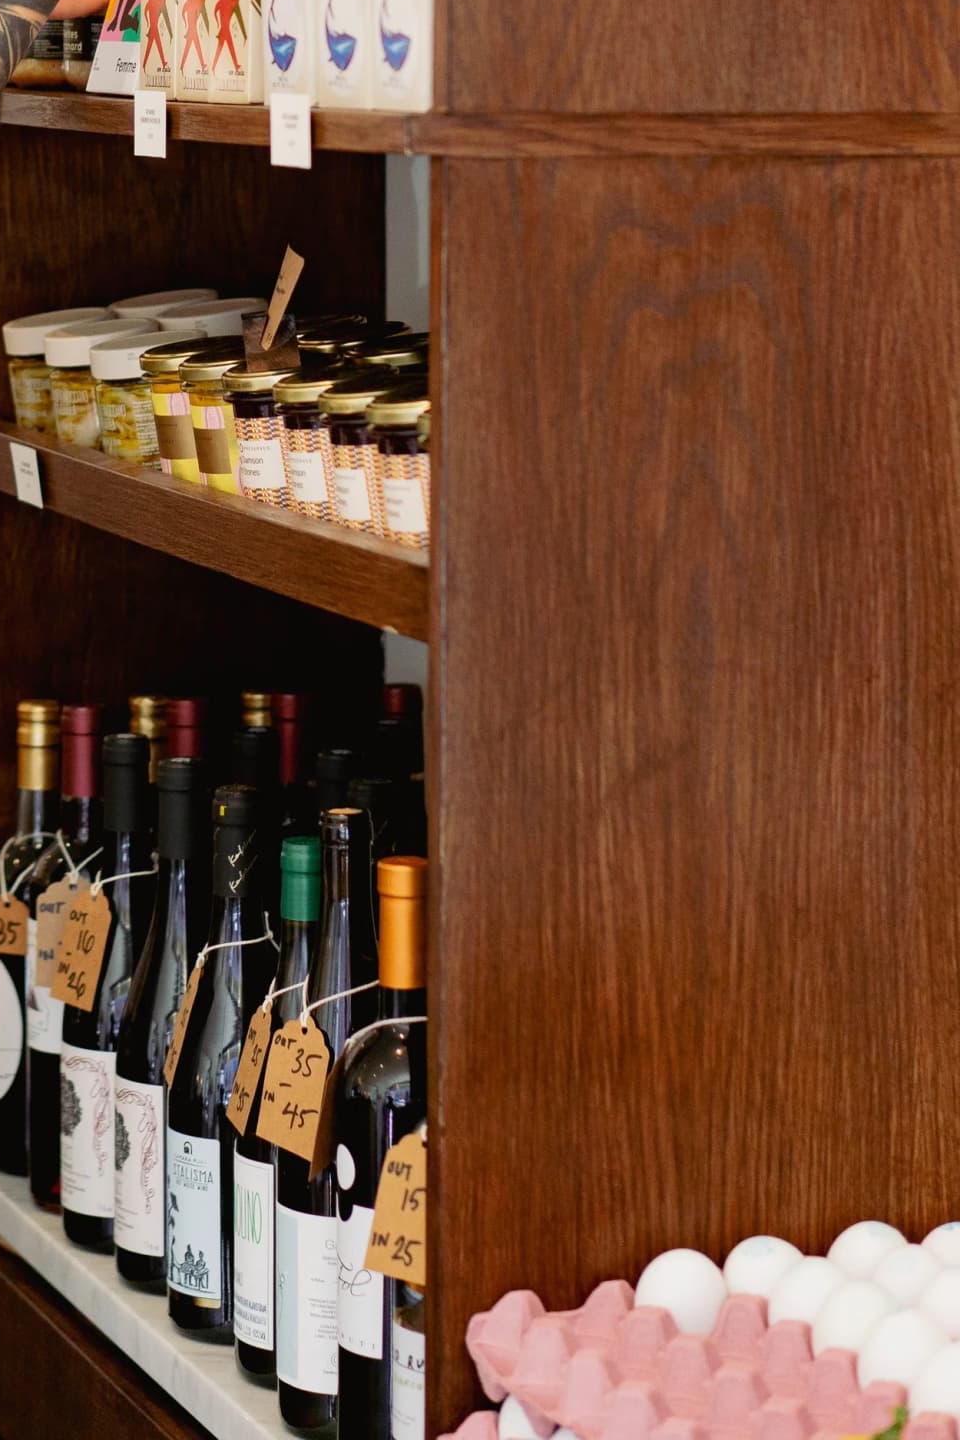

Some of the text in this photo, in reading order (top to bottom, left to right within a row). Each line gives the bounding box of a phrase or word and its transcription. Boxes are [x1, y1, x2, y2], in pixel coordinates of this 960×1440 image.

[70, 910, 88, 925] OUT
[77, 929, 95, 956] 16
[58, 962, 70, 974] IN
[275, 1034, 323, 1078] OUT 35
[264, 1090, 319, 1130] IN 45
[387, 1160, 412, 1181] OUT
[401, 1187, 427, 1211] 15
[371, 1231, 421, 1267] IN 25
